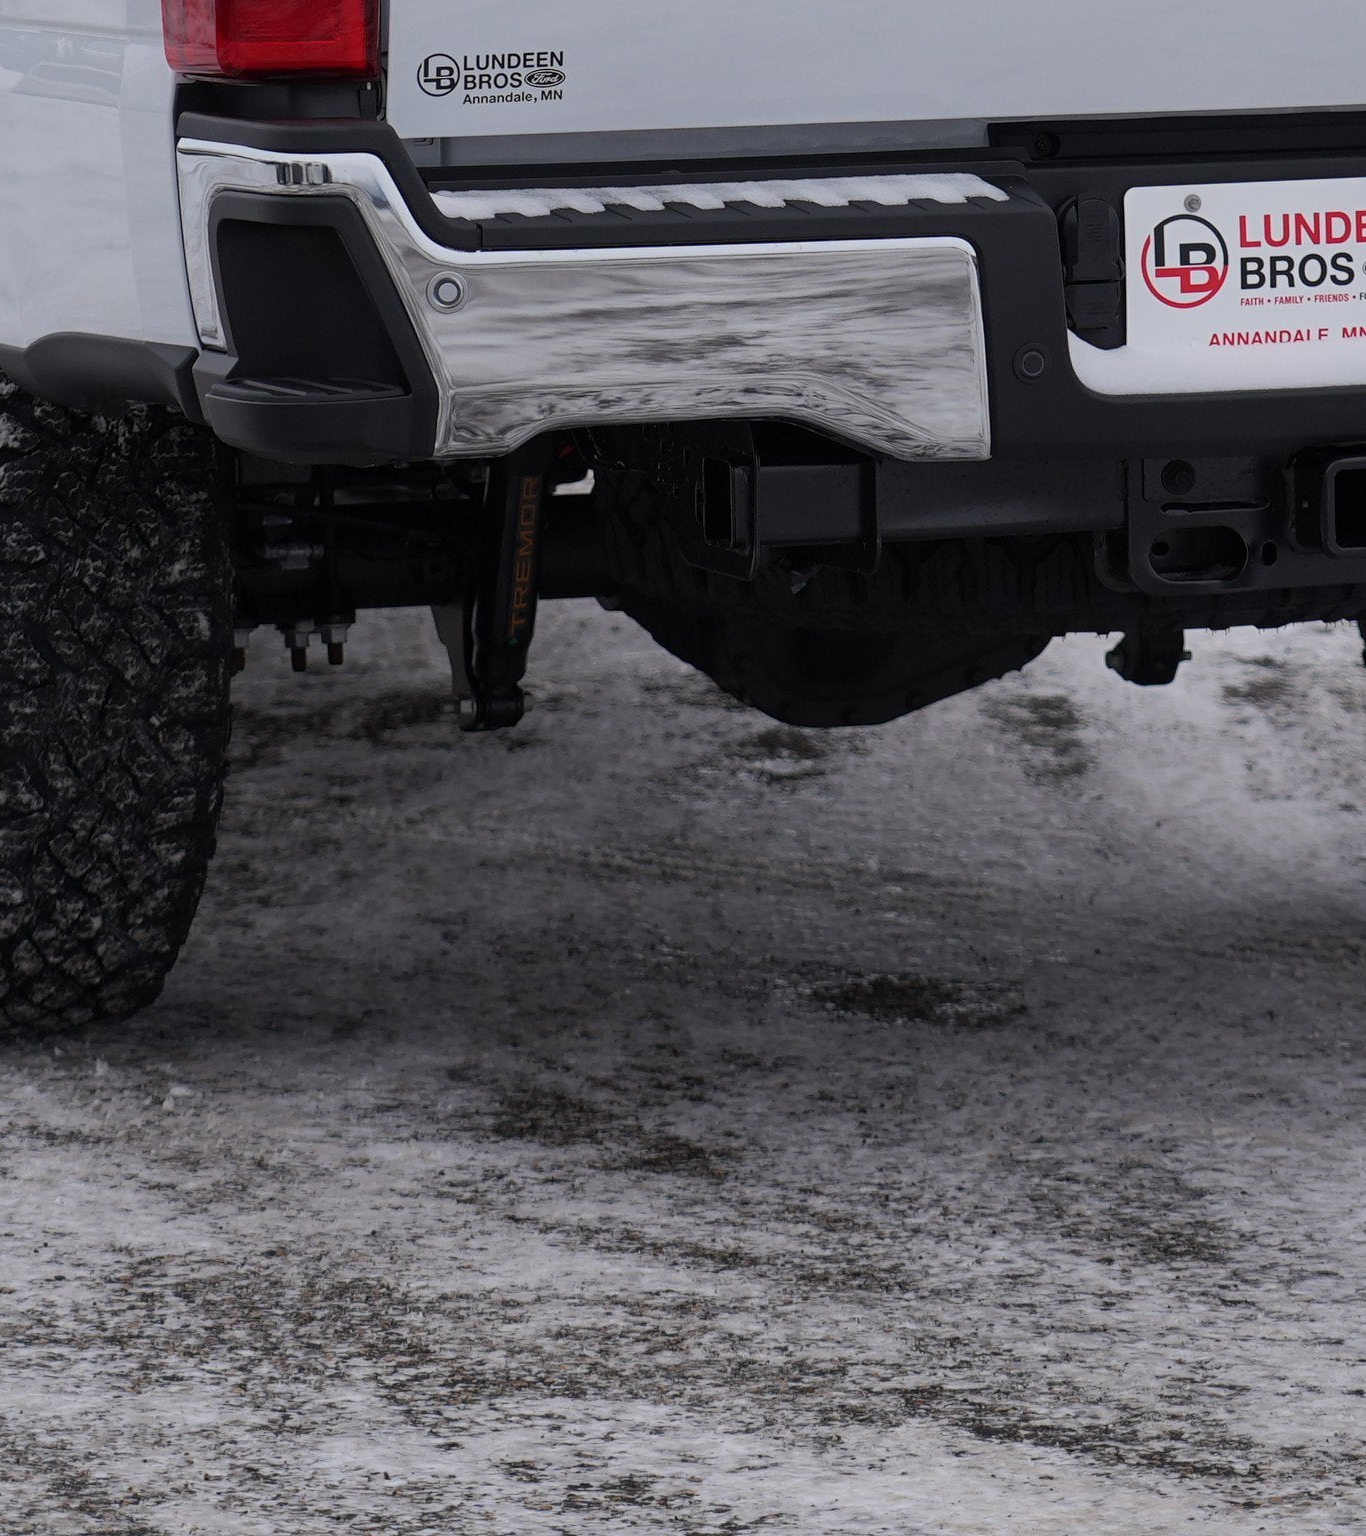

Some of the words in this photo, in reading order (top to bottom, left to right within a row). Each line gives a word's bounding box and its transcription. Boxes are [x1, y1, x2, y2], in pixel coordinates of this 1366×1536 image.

[463, 51, 564, 71] LUNDEEN
[463, 72, 523, 91] BROS
[462, 91, 538, 105] Annandale,
[540, 90, 564, 101] MN
[1239, 252, 1355, 290] BROS
[1240, 297, 1264, 306] FAITH
[1274, 295, 1304, 305] FAMILY
[1314, 293, 1350, 303] FRIENDS
[507, 474, 540, 637] TREMOR
